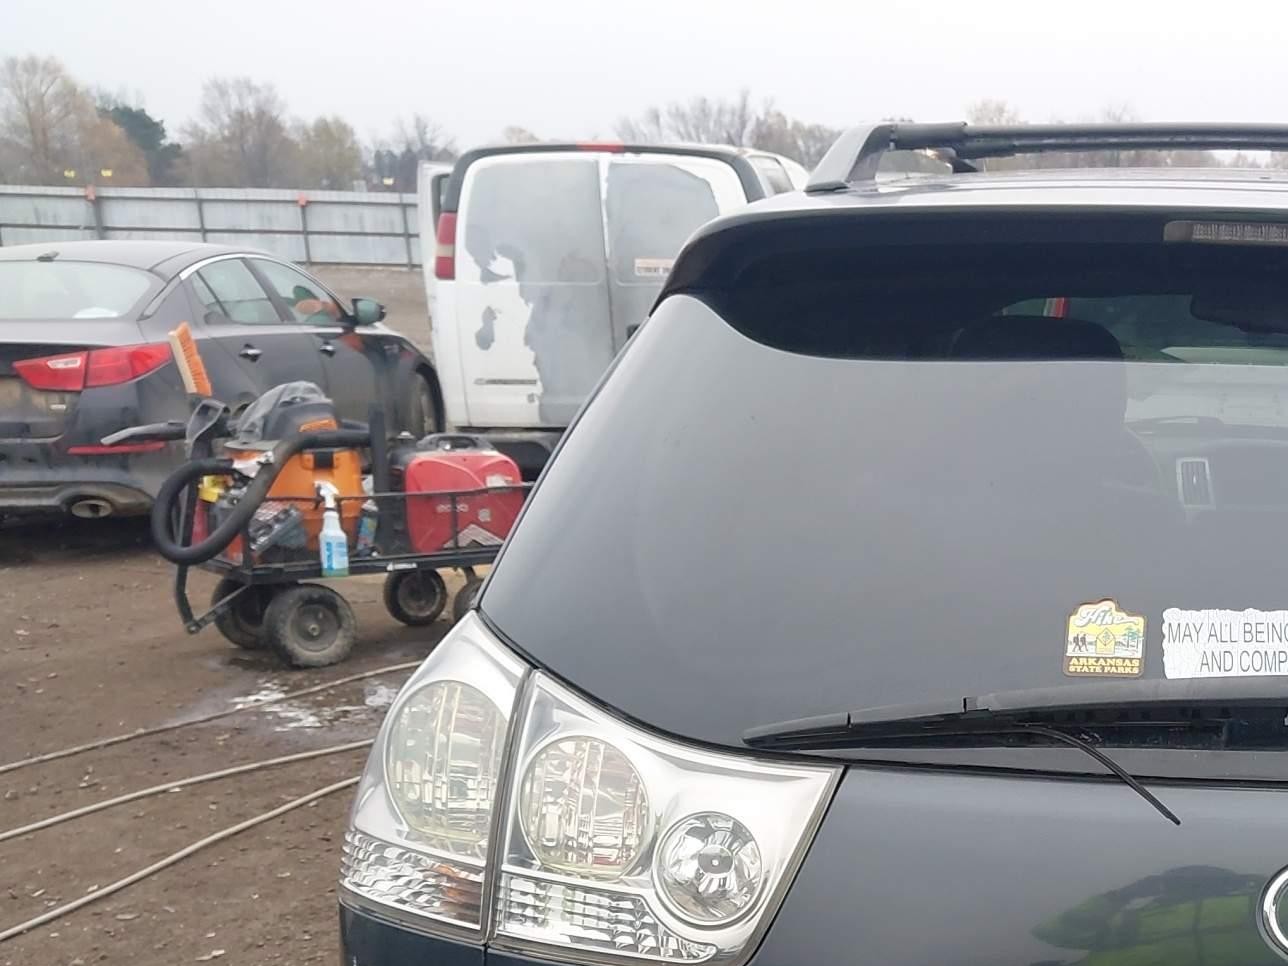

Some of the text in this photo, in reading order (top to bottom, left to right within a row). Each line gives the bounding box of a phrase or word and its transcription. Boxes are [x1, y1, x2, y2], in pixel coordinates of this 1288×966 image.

[1167, 622, 1204, 644] MAY
[1207, 622, 1239, 644] ALL
[1069, 657, 1140, 667] ARKANSAS
[1200, 650, 1234, 673] AND
[1103, 666, 1140, 674] PARKS
